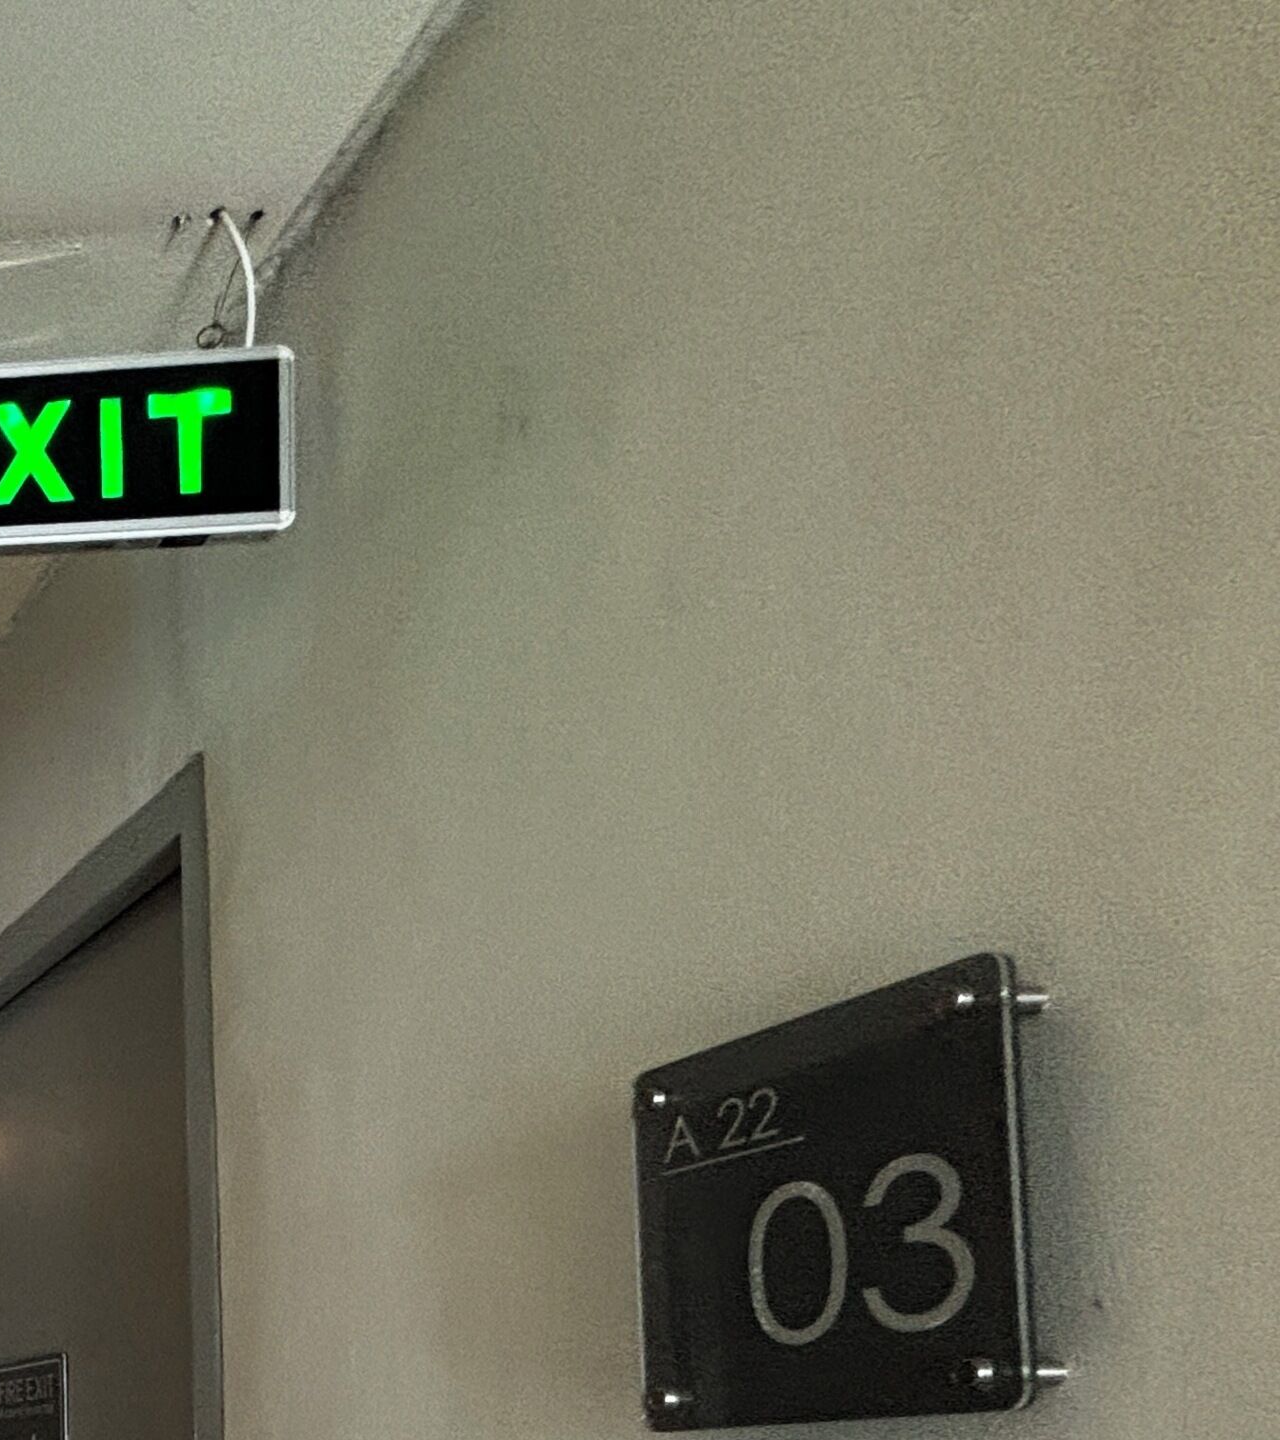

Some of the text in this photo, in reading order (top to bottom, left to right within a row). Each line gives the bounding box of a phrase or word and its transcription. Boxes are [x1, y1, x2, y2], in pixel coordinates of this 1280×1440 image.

[664, 1087, 781, 1164] A 22
[748, 1152, 976, 1346] 03
